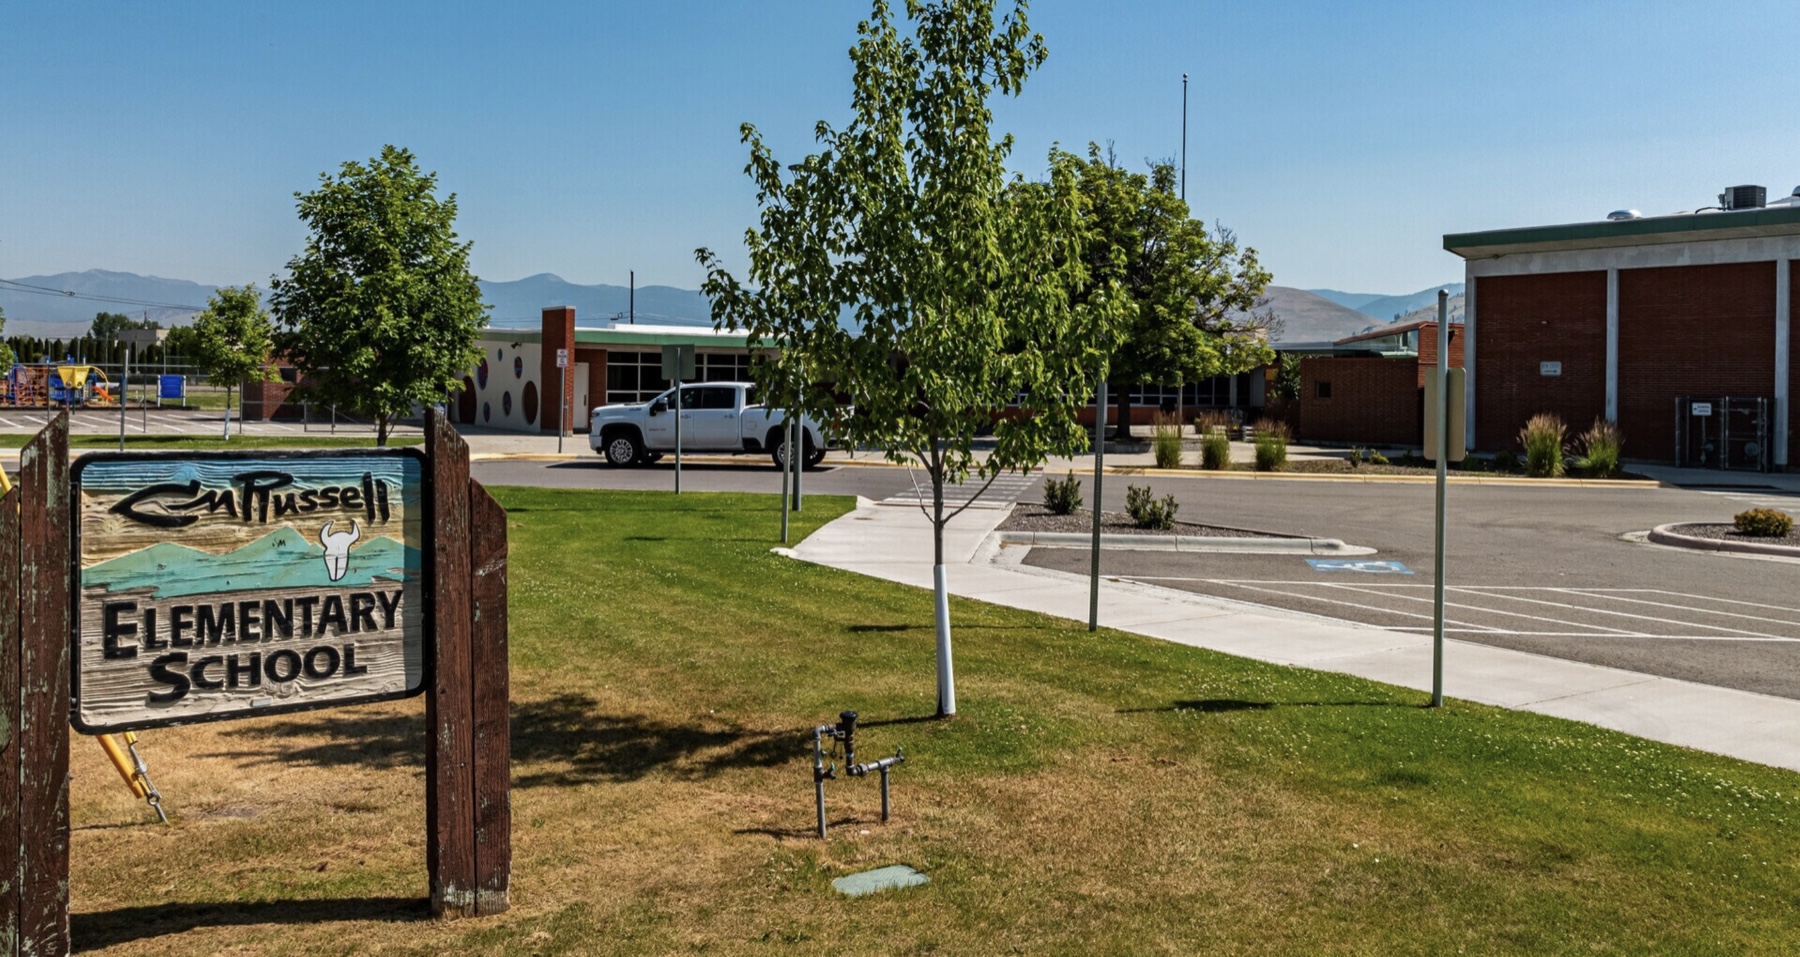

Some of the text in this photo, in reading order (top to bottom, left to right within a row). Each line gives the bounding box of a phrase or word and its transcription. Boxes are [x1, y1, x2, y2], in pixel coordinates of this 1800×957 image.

[233, 471, 390, 525] Russell
[102, 589, 403, 659] ELEMENTARY
[147, 643, 368, 703] SCHOOL
